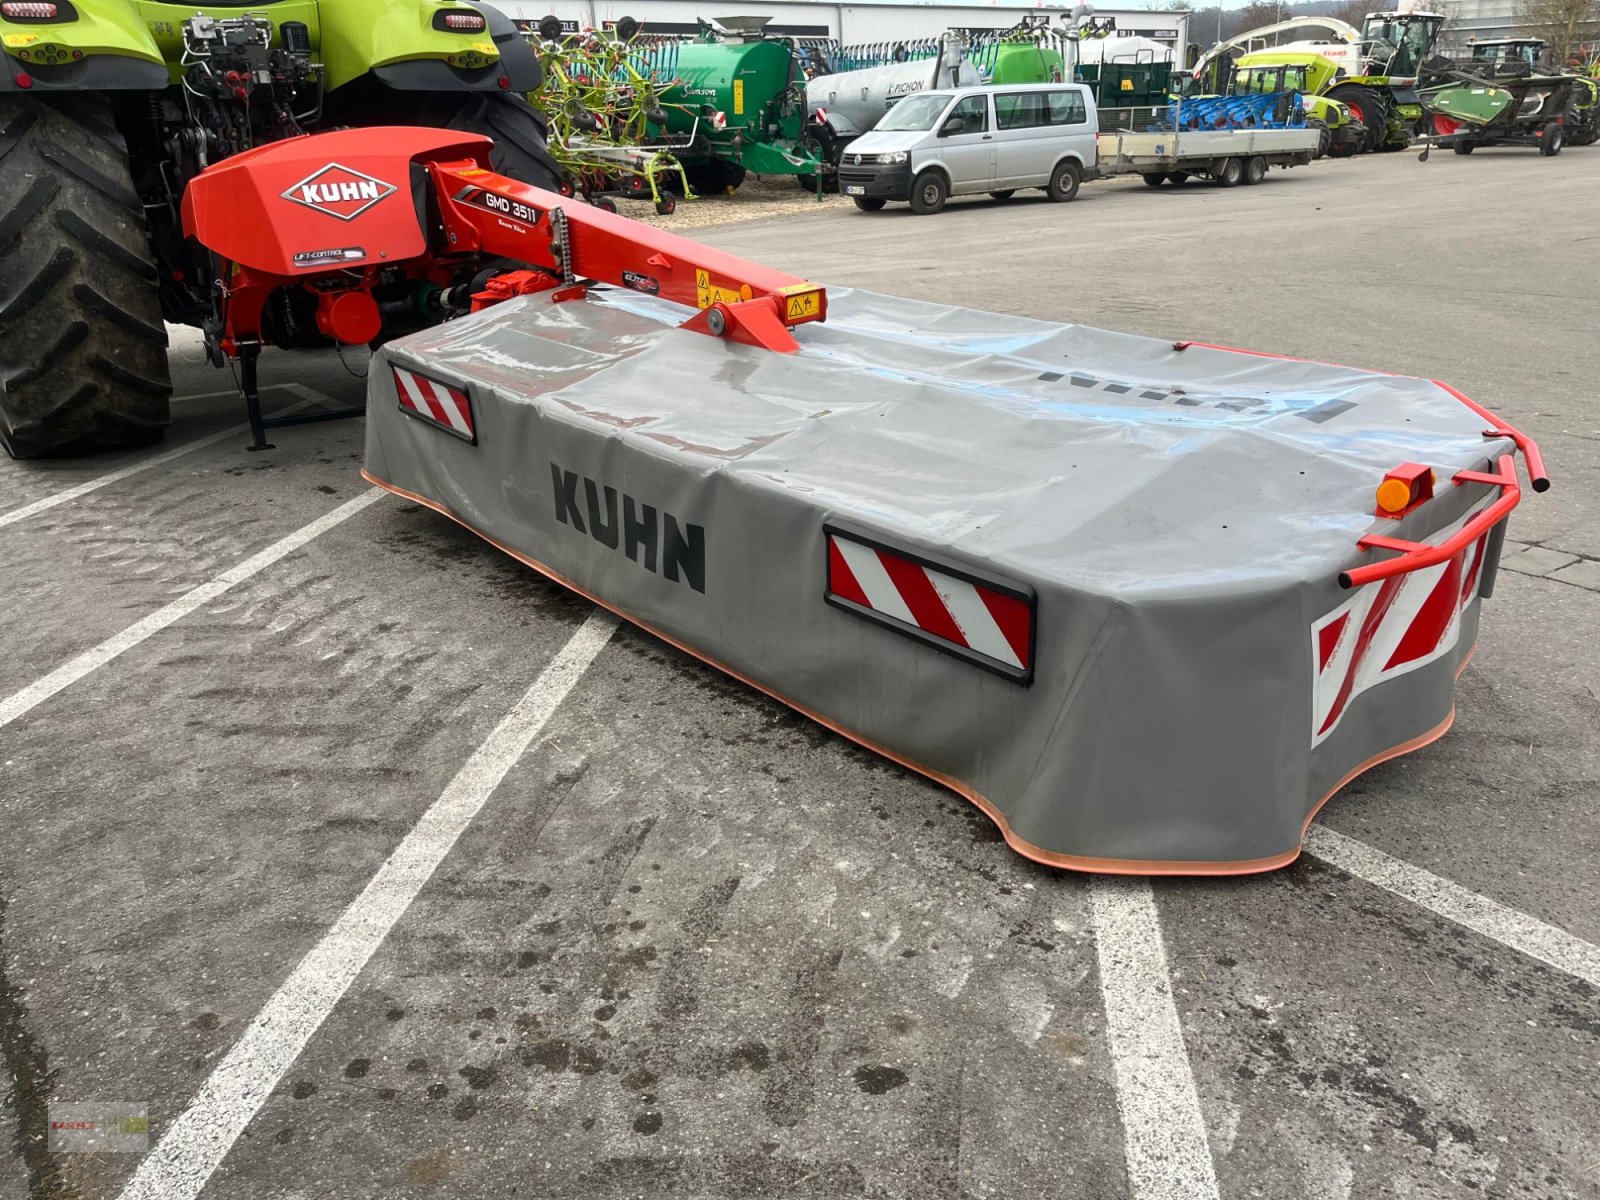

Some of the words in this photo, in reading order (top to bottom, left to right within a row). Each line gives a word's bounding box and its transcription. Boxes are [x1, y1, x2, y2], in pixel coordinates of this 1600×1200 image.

[680, 83, 716, 98] Samson
[894, 80, 924, 93] PICHON
[302, 181, 379, 203] KUHN
[486, 193, 510, 212] GMD
[512, 202, 536, 223] 3511
[294, 249, 345, 261] LIFT-CONTROL
[550, 461, 706, 595] KUHN
